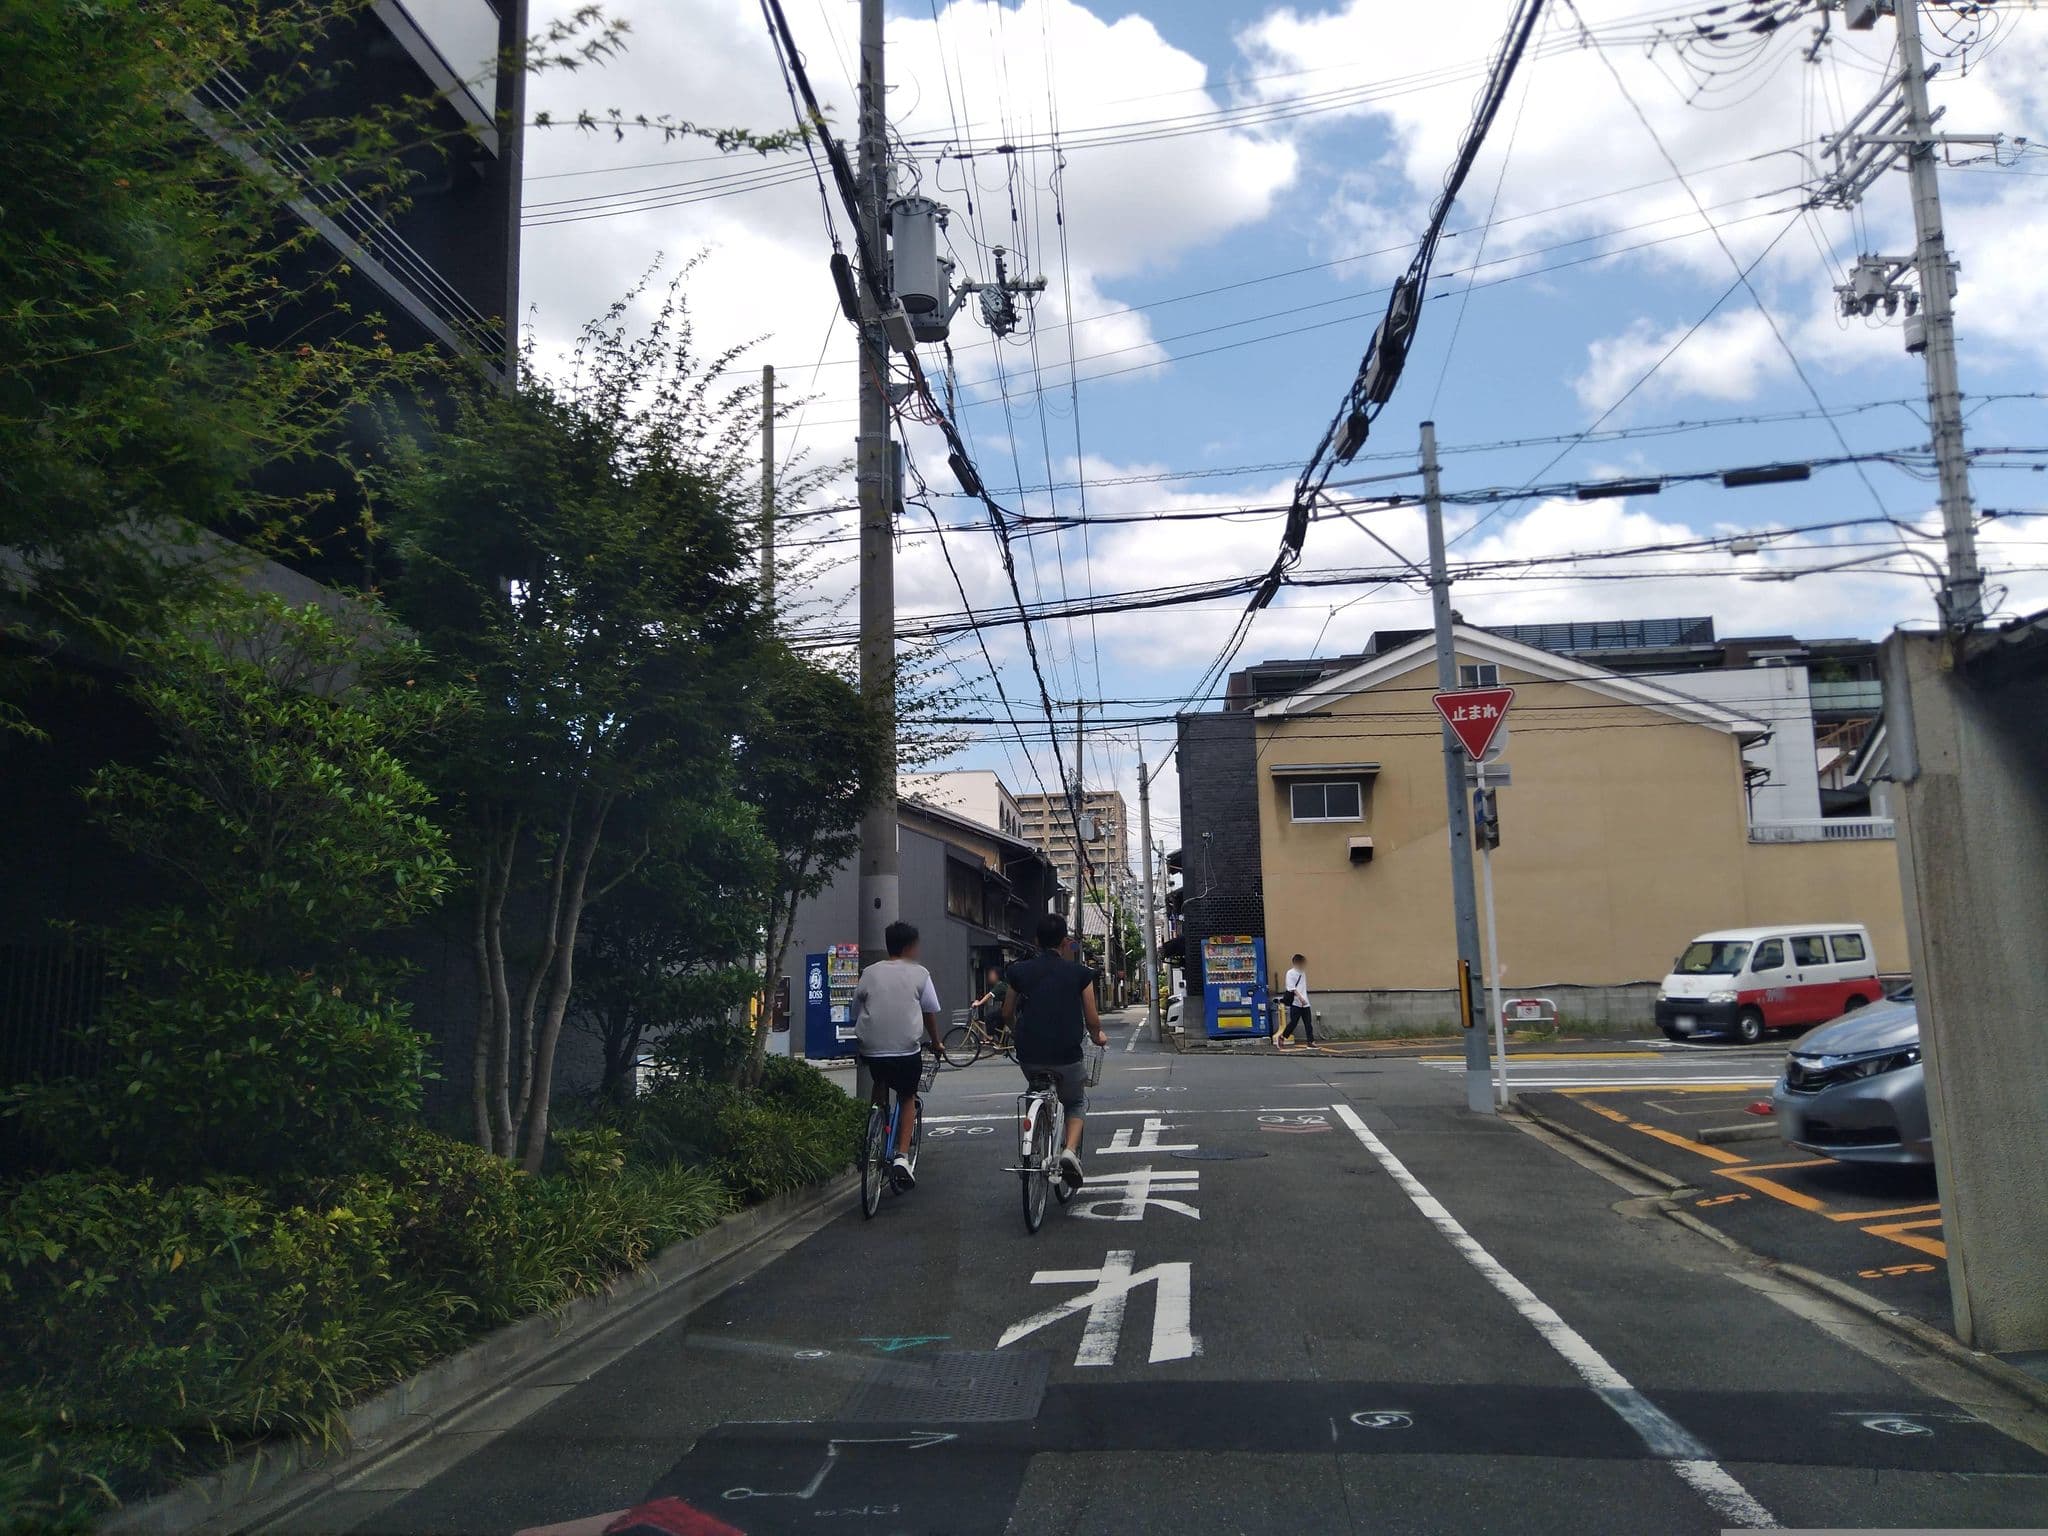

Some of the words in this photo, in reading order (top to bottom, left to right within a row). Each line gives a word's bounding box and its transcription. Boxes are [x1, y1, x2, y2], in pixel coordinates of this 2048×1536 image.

[1452, 703, 1499, 722] 止まれ
[808, 990, 824, 1000] BOSS
[995, 1118, 1202, 1367] 止まれ
